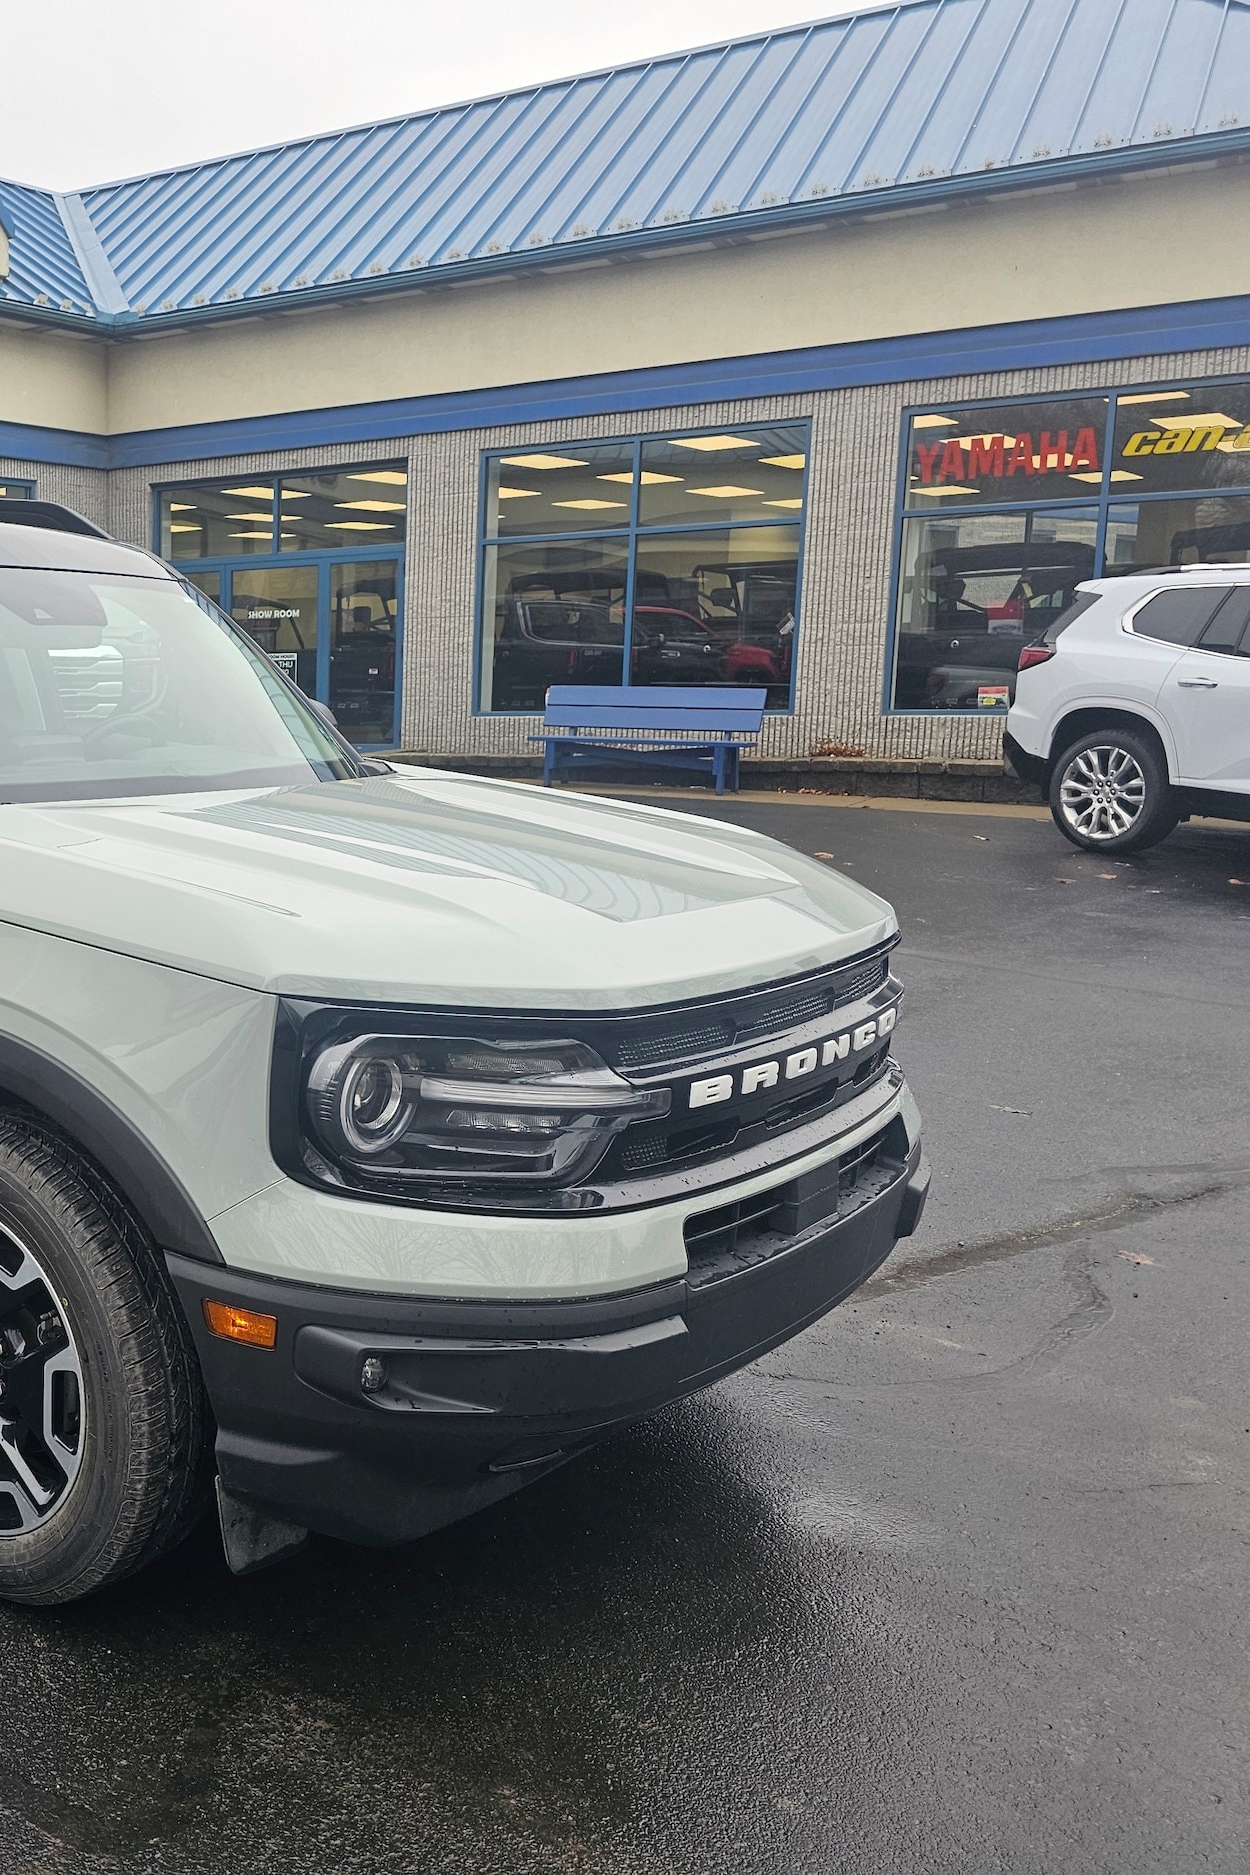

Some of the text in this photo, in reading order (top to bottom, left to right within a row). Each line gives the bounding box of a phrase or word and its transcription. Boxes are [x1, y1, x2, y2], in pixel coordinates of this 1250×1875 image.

[916, 427, 1099, 484] YAMAHA
[248, 609, 300, 619] SHOW ROOM
[689, 1008, 896, 1109] BRONCO
